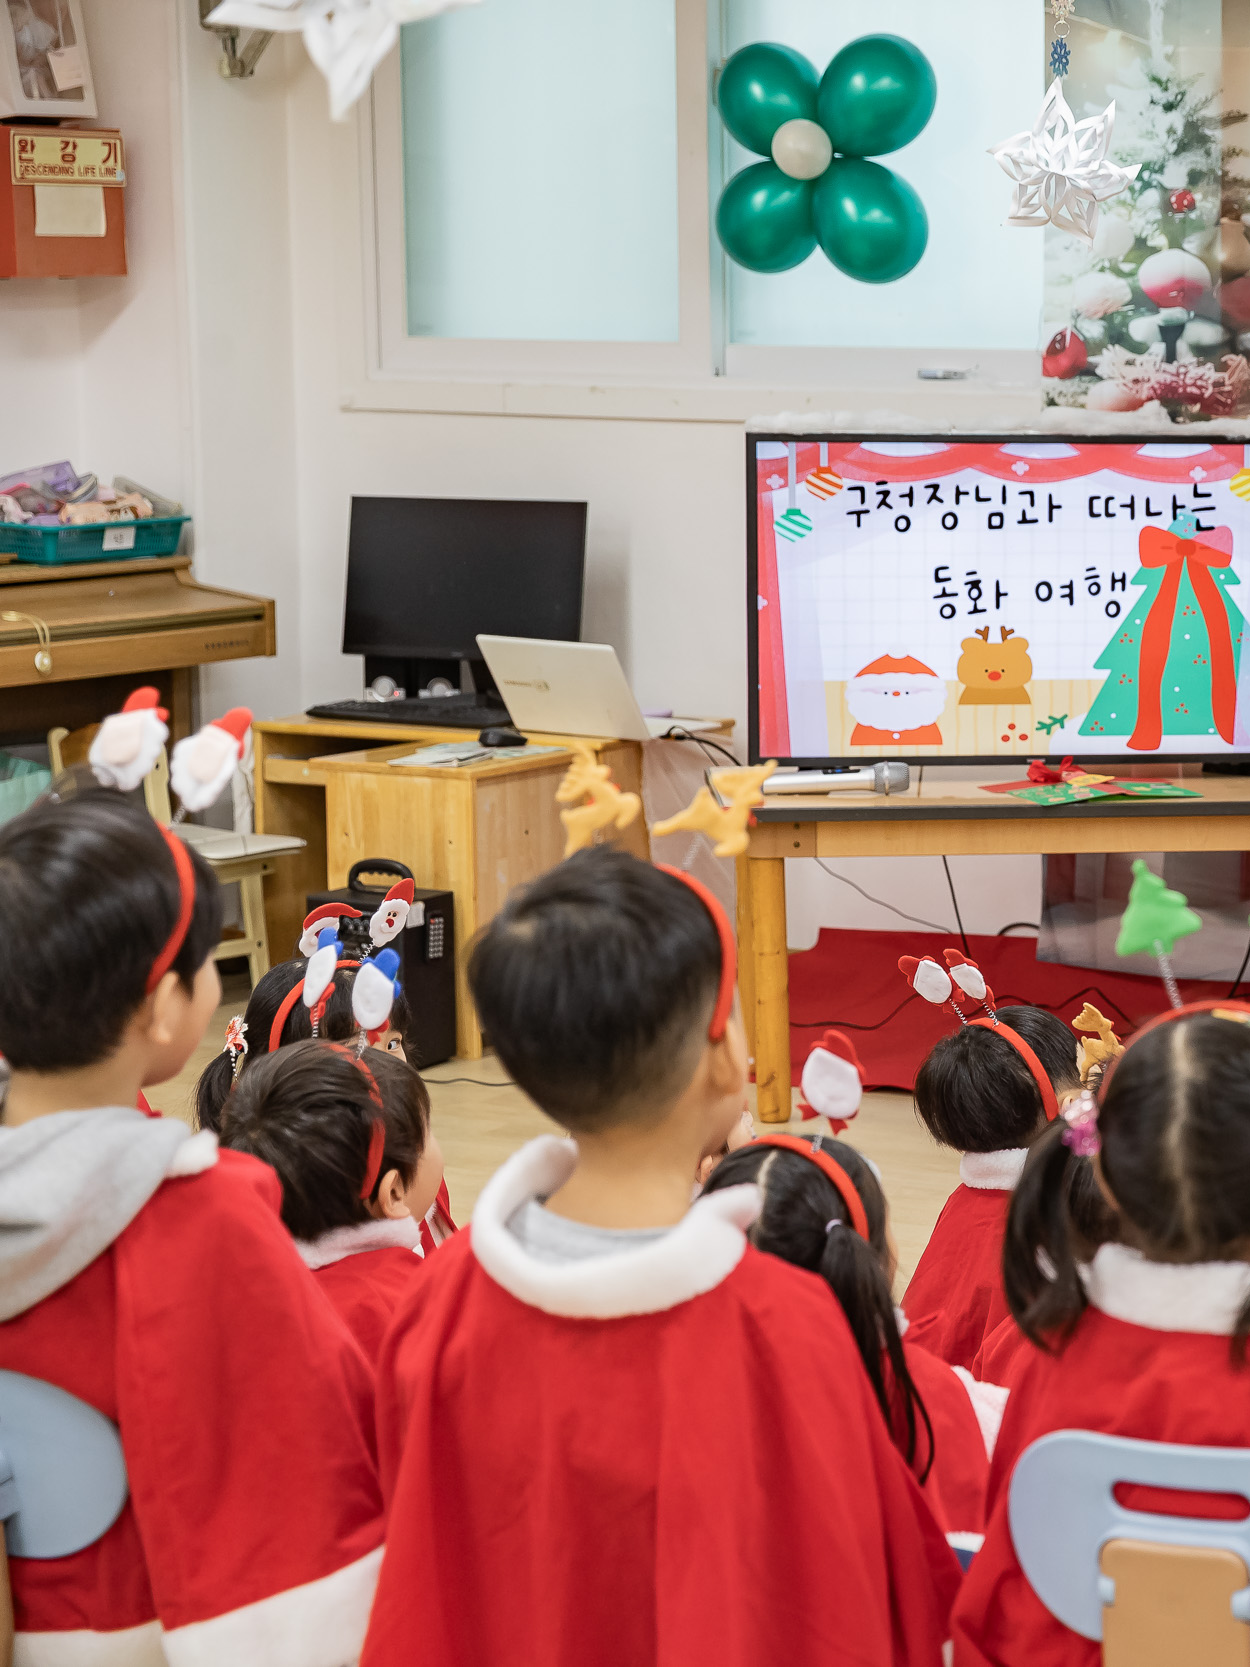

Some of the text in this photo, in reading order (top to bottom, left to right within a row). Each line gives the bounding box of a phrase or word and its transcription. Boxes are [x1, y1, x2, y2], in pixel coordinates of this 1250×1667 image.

[18, 139, 118, 164] 완강기
[78, 166, 96, 177] LIFE
[99, 167, 117, 178] LINE
[846, 481, 1217, 532] 구청장님과 떠나는
[933, 565, 1127, 619] 동화 여행
